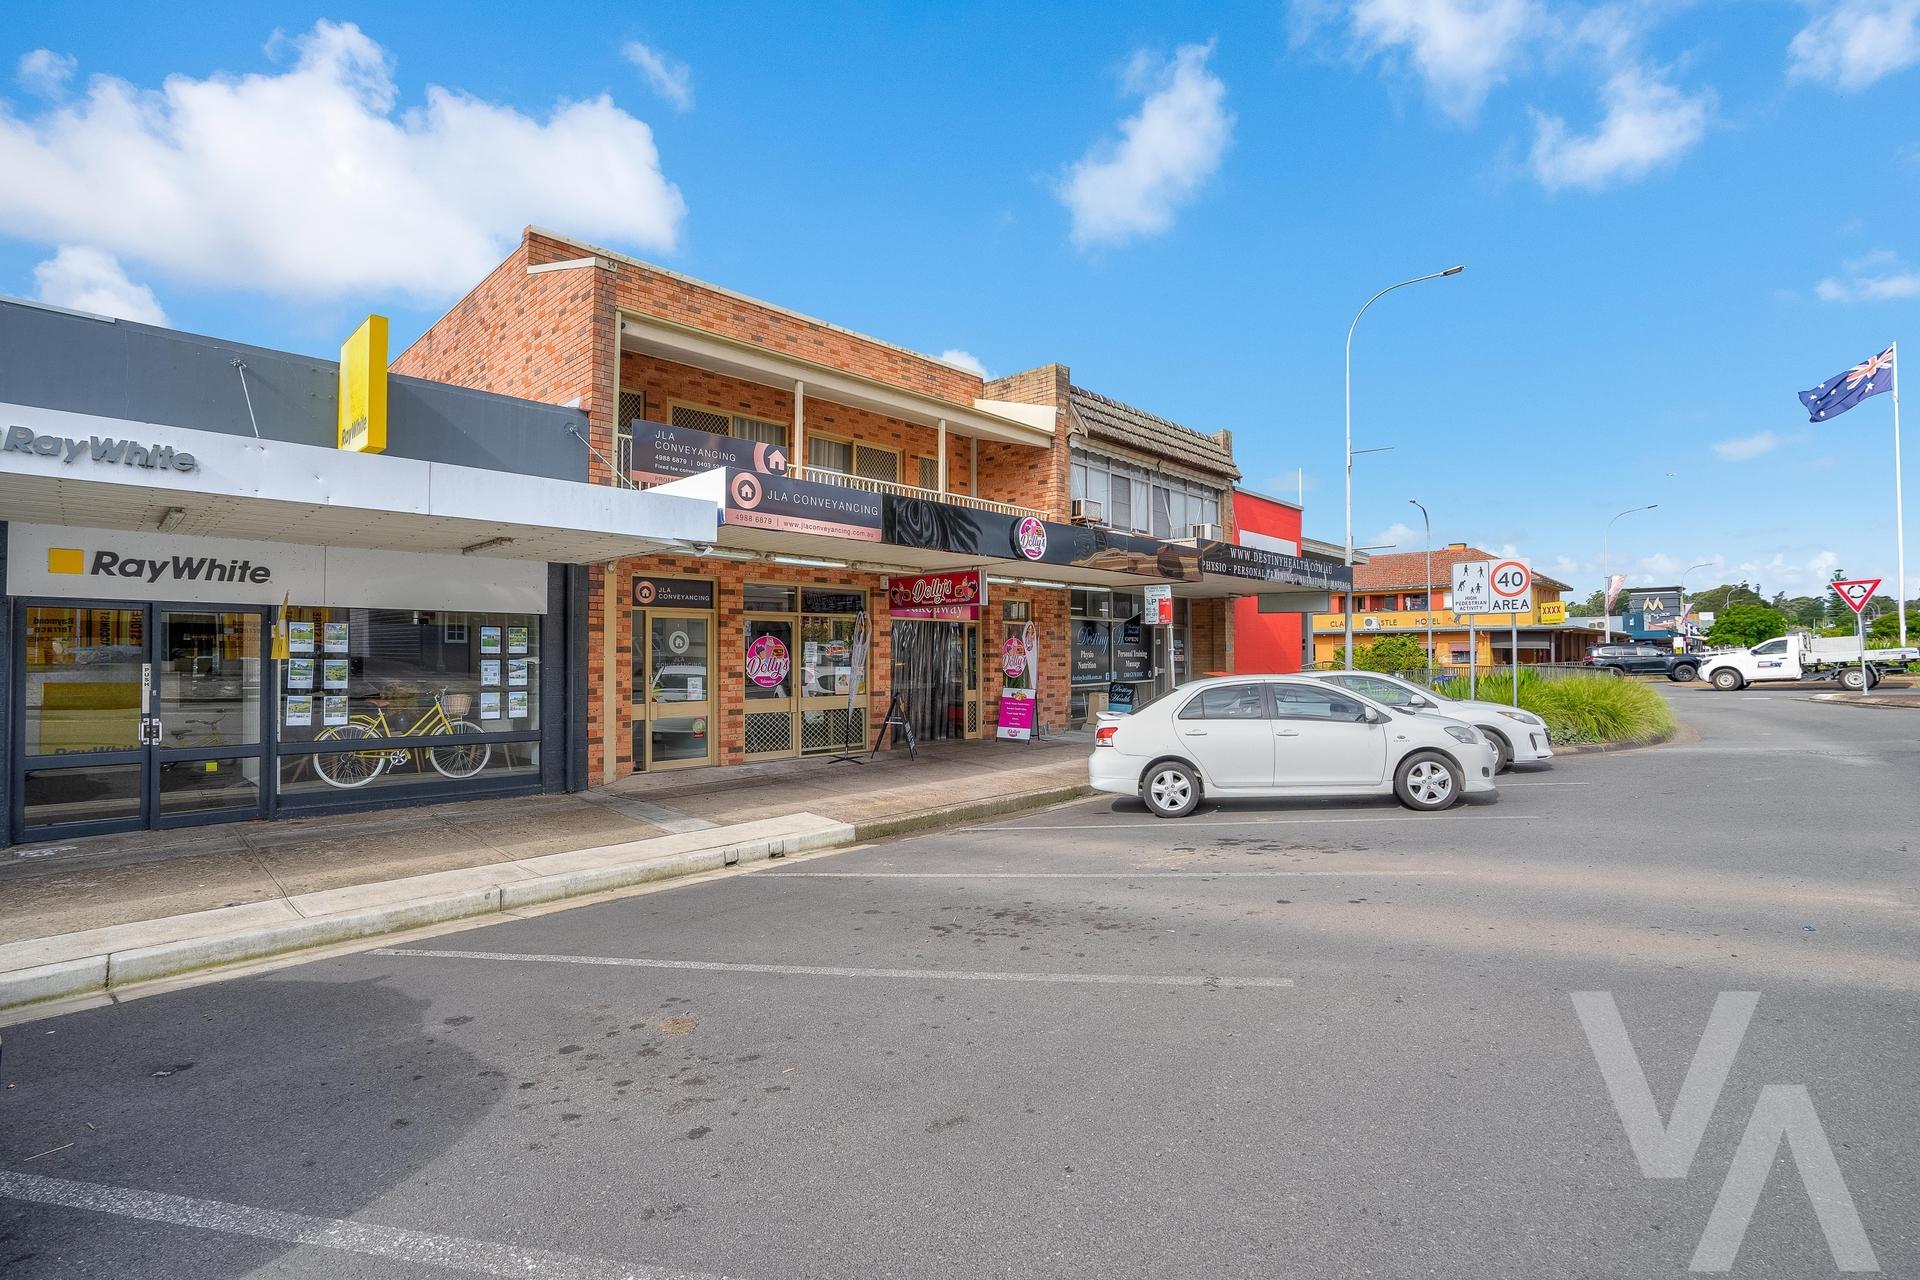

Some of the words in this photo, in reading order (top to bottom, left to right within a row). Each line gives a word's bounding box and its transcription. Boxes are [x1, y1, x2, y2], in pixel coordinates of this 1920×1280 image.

[655, 430, 675, 441] JLA
[4, 425, 195, 472] RayWhite
[655, 440, 736, 462] CONVEYANCING
[655, 454, 671, 462] 4988
[767, 490, 788, 502] JLA
[793, 493, 878, 516] CONVEYANCING
[735, 513, 752, 522] 4988
[755, 515, 772, 525] 6879
[783, 521, 874, 538] www.jlaconveyancing.com.au
[91, 550, 271, 585] RayWhite
[1202, 561, 1227, 573] PHYSIO
[1233, 564, 1265, 579] PERSONAL
[1265, 569, 1294, 581] TRAINING
[1497, 571, 1524, 587] 40
[658, 593, 710, 601] CONVEYANCING
[912, 578, 952, 604] Dolly's
[1492, 598, 1530, 610] AREA
[1542, 605, 1561, 615] XXXX
[1080, 650, 1094, 659] Physio
[1117, 650, 1132, 658] Personal
[746, 655, 789, 679] Dolly's
[1077, 661, 1097, 669] Nutrition
